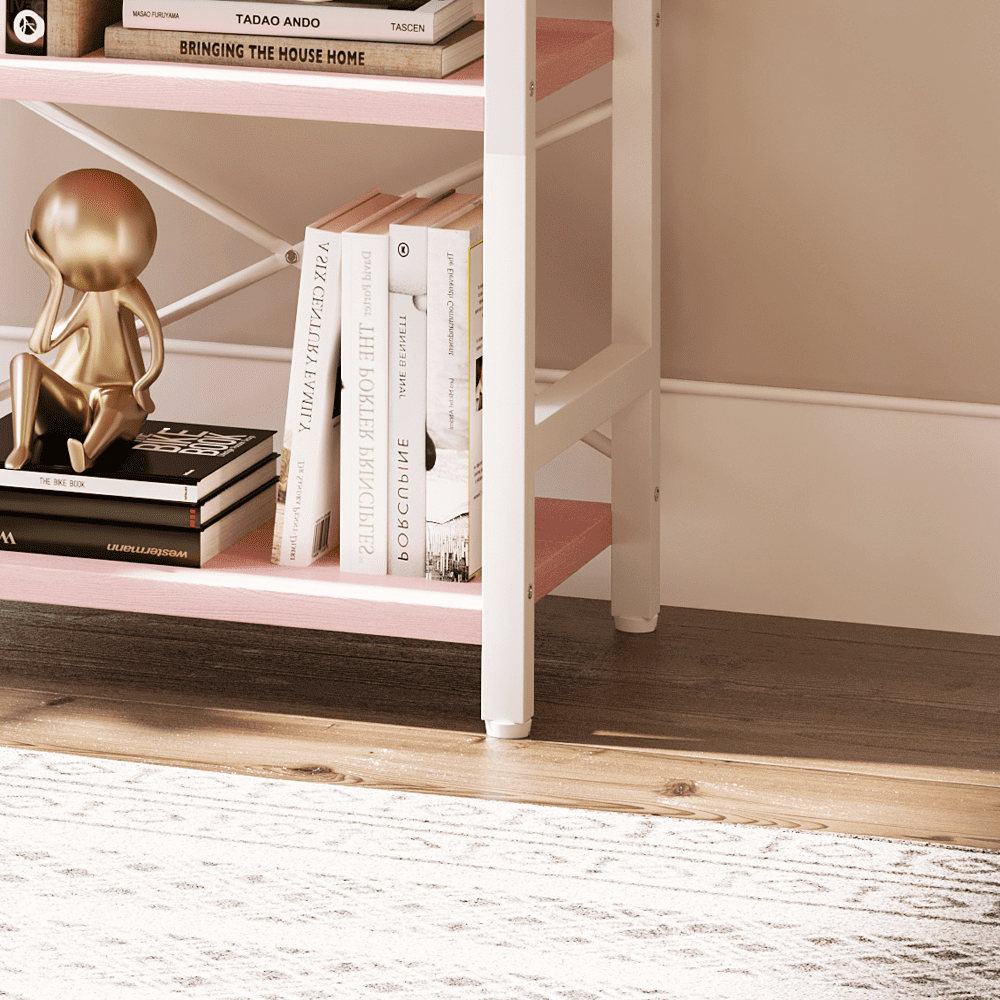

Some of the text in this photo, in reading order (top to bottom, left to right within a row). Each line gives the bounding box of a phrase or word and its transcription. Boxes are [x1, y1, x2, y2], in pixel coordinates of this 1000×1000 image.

[151, 11, 180, 19] FURUYAMA
[236, 14, 320, 28] TADAO ANDO
[391, 23, 424, 32] TASCEN
[179, 40, 364, 65] BRINGING THE HOUSE HOME
[40, 477, 85, 488] THE BIKE BOOK
[107, 544, 187, 558] westermann
